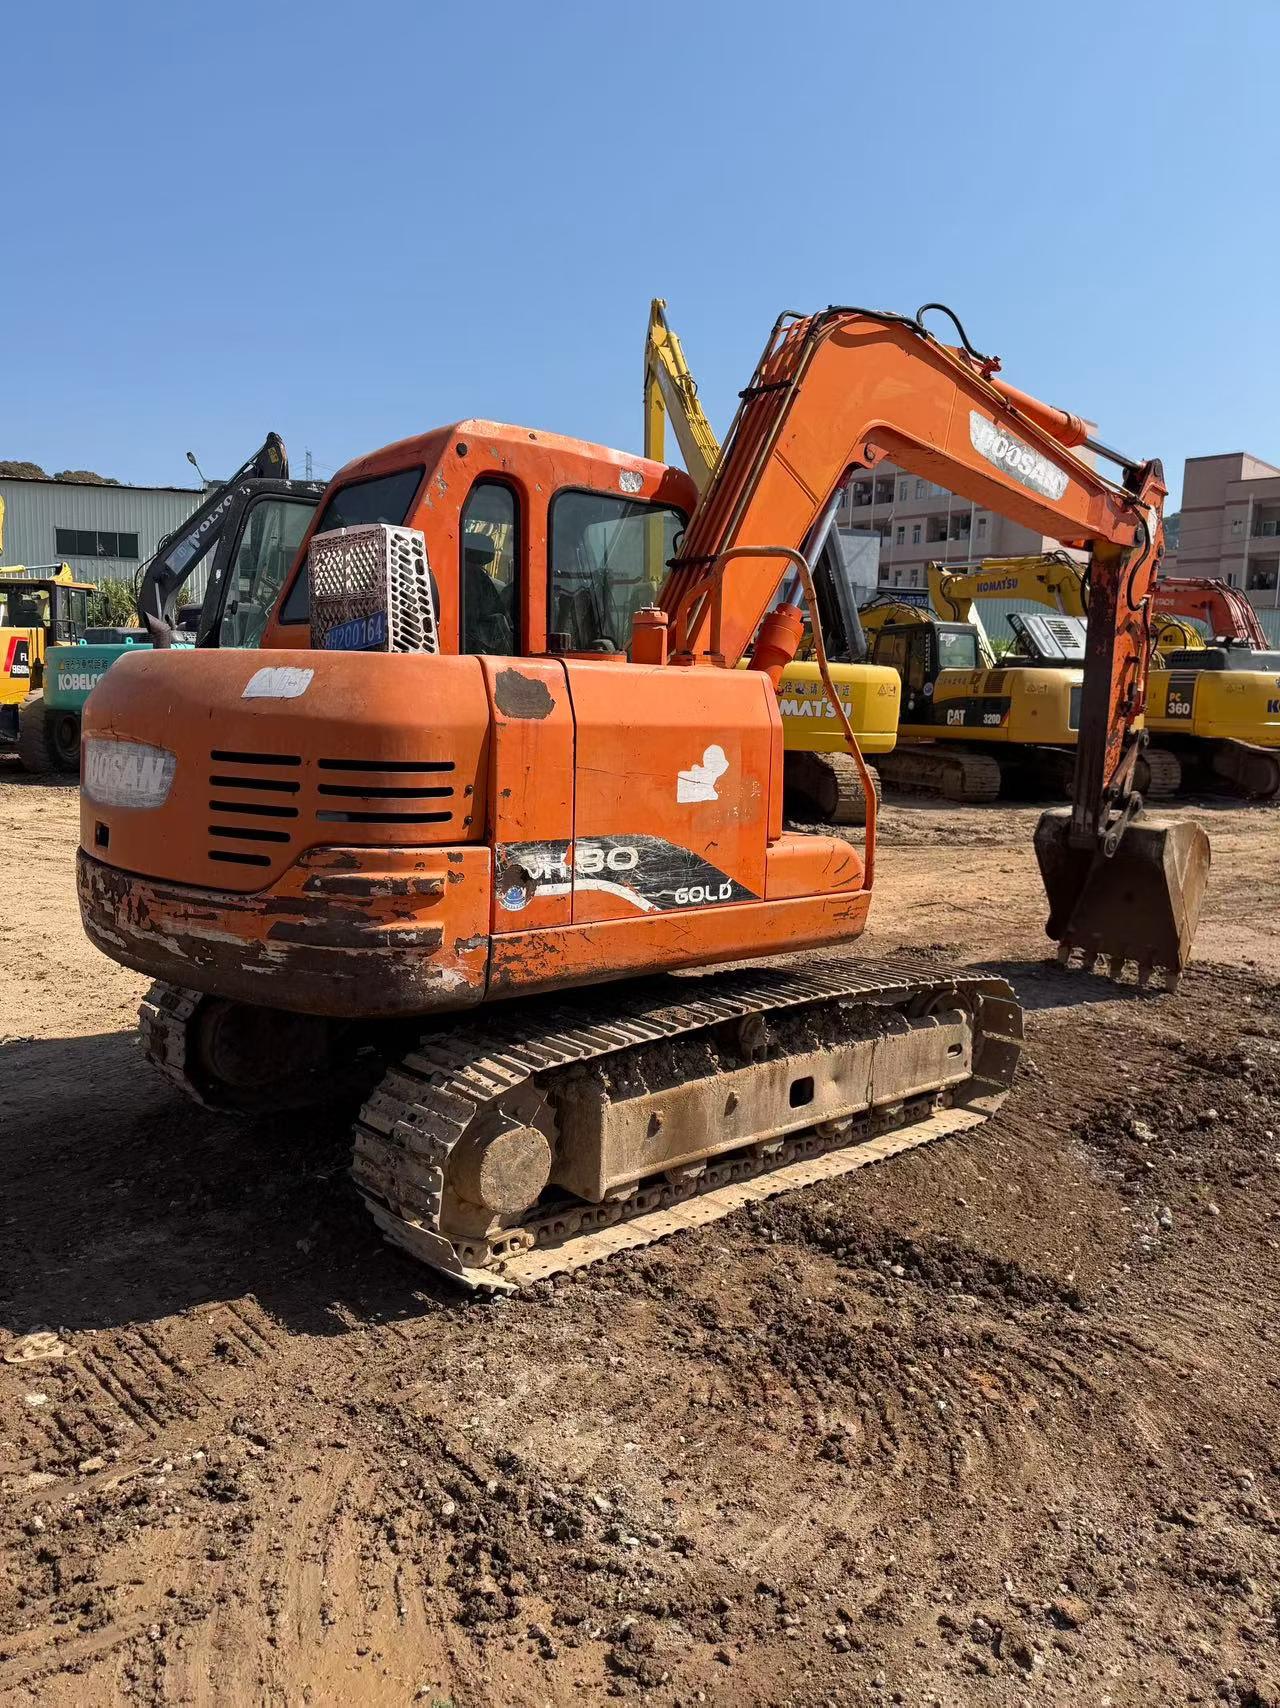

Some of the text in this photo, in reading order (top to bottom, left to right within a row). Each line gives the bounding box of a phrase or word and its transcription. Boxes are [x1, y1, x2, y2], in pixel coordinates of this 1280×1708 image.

[188, 495, 233, 549] VOLVO
[976, 577, 1019, 592] KOMATSU
[1169, 693, 1181, 701] PC
[1168, 703, 1190, 714] 360
[1266, 699, 1280, 713] K
[946, 709, 966, 725] CAT
[674, 882, 732, 904] GOLD
